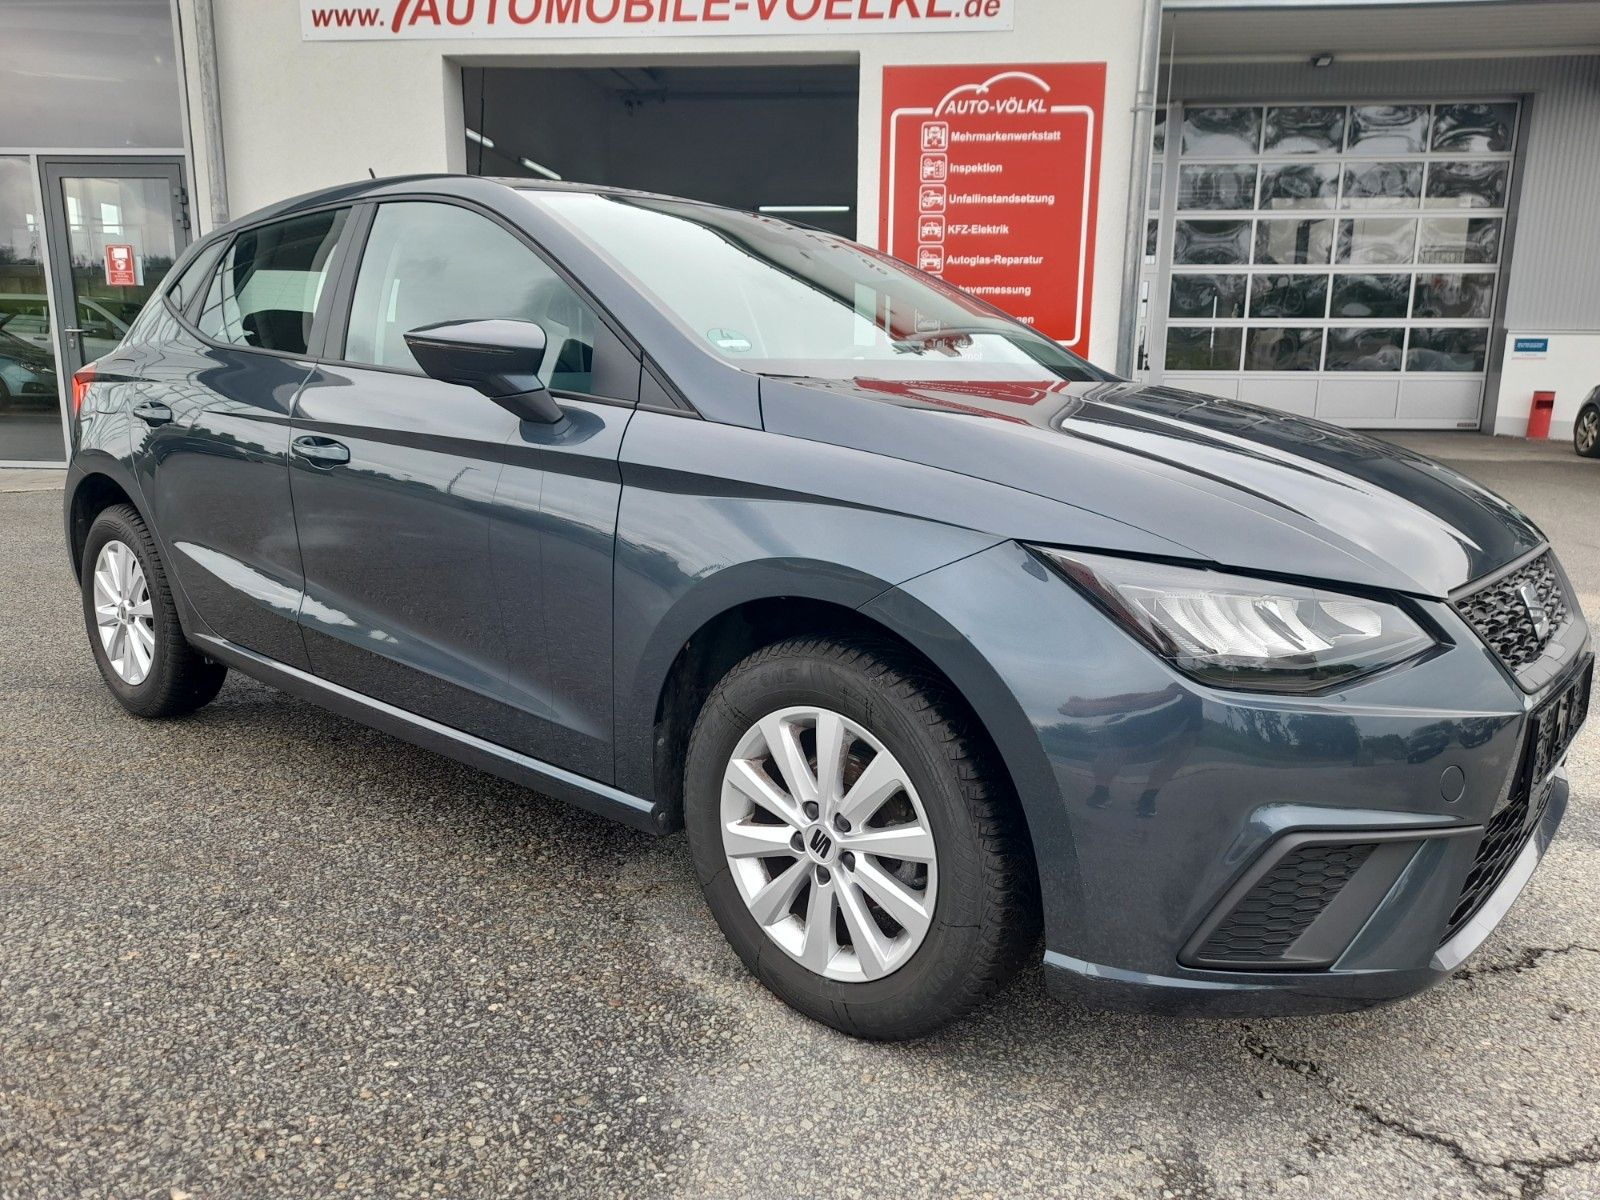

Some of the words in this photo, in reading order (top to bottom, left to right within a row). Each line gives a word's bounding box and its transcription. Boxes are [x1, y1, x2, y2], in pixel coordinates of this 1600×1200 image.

[946, 97, 1047, 114] AUTO-VÖLKL
[950, 130, 1061, 142] Mehrmarkenwerkstatt
[949, 163, 1003, 174] Inspektion
[948, 193, 1055, 206] Unfallinstandsetzung
[947, 224, 1009, 235] KFZ-Elektrik
[946, 254, 1043, 267] Autoglas-Reparatur
